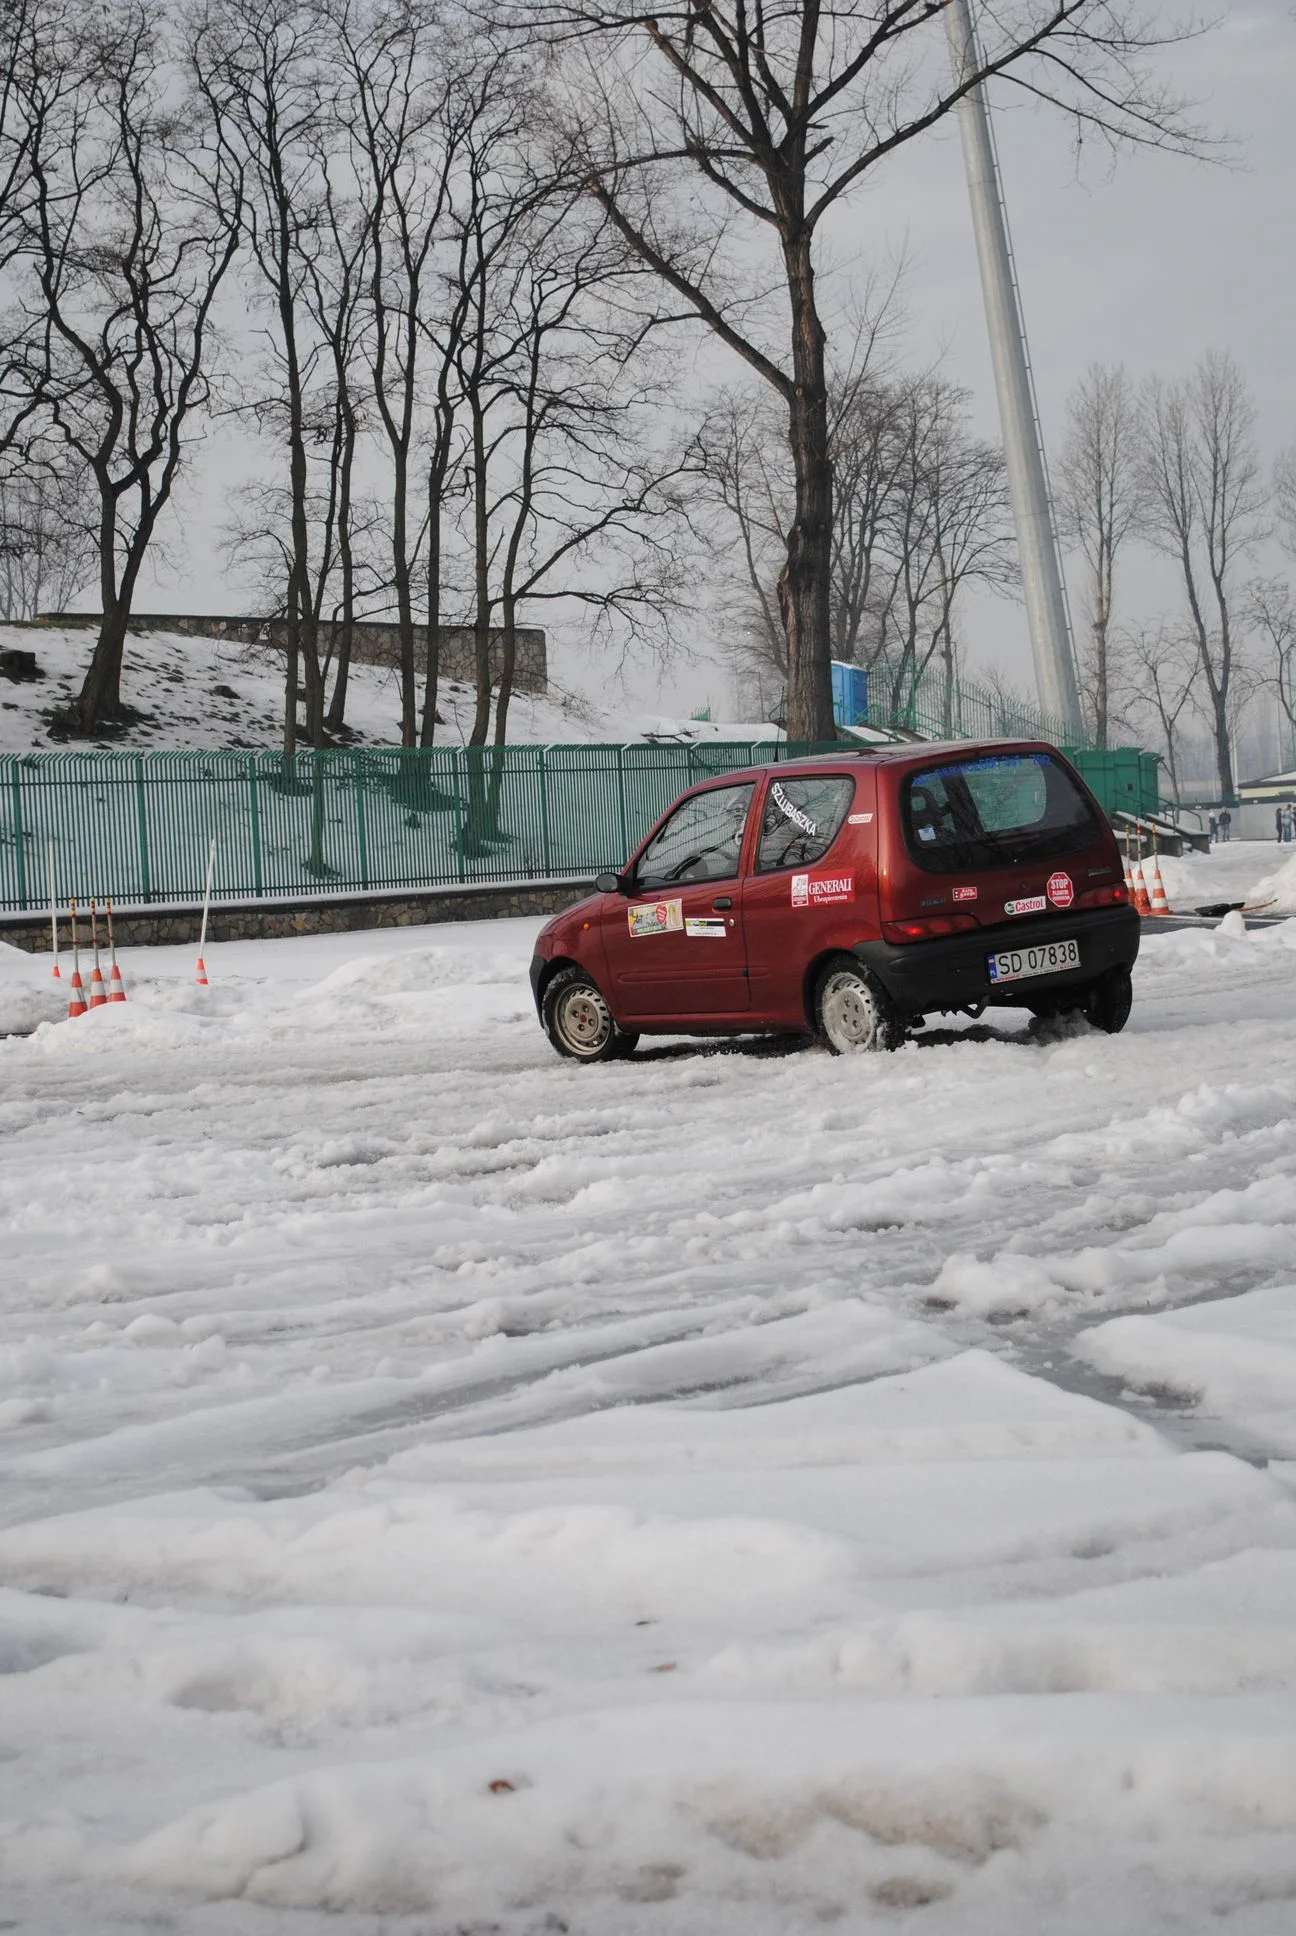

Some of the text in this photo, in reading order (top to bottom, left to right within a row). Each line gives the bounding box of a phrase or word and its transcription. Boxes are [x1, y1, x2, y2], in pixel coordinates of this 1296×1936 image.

[809, 878, 852, 895] GENERALI
[1050, 878, 1068, 890] STOP
[1015, 898, 1044, 912] Castrol
[998, 953, 1022, 975] SD
[1028, 942, 1077, 969] 07838
